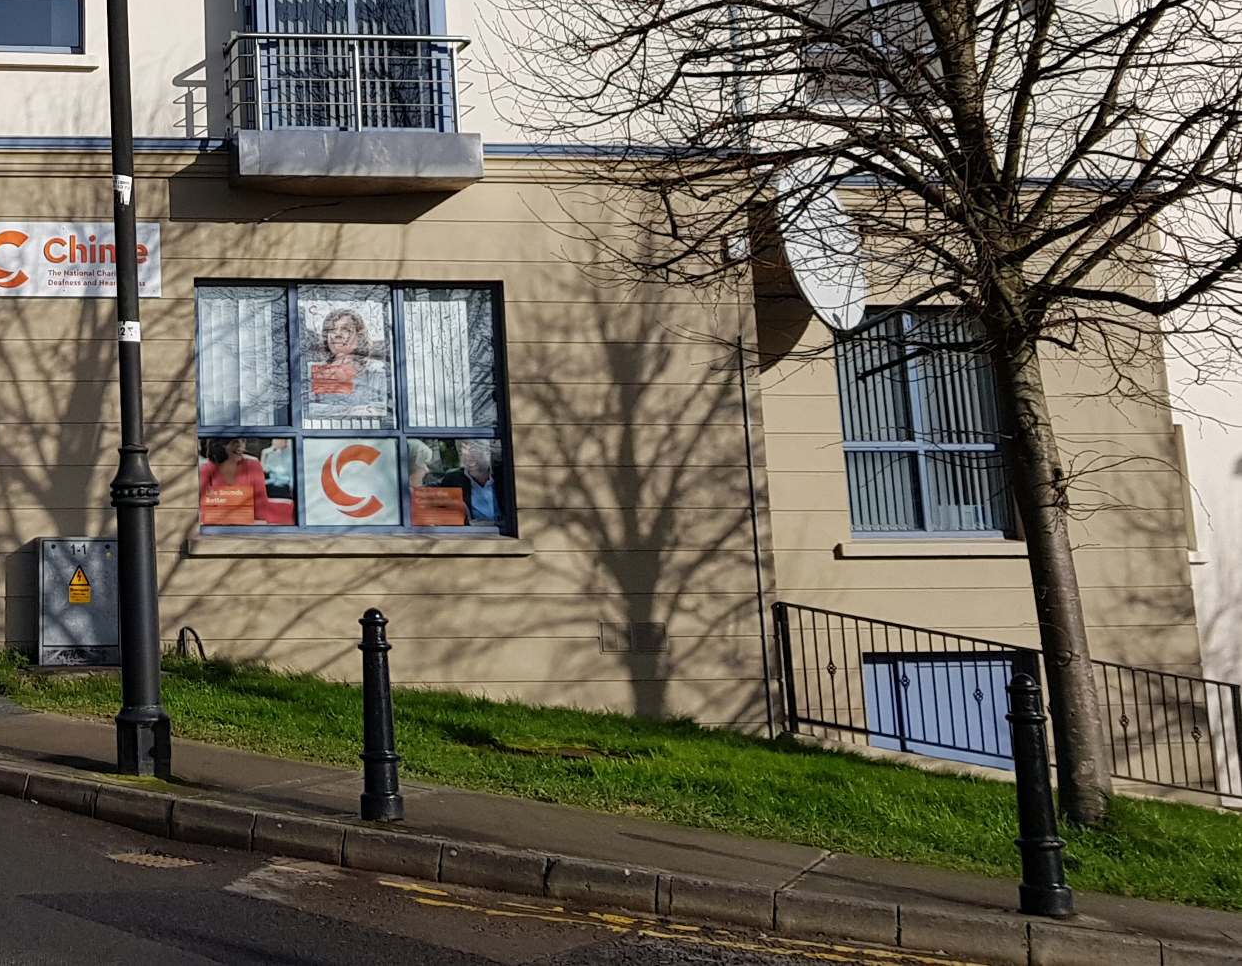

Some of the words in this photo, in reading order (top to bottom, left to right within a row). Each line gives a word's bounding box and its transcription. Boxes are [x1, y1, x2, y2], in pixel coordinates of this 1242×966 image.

[48, 269, 62, 277] The
[63, 269, 95, 277] National
[96, 269, 117, 277] Chari
[70, 544, 86, 555] 1-1
